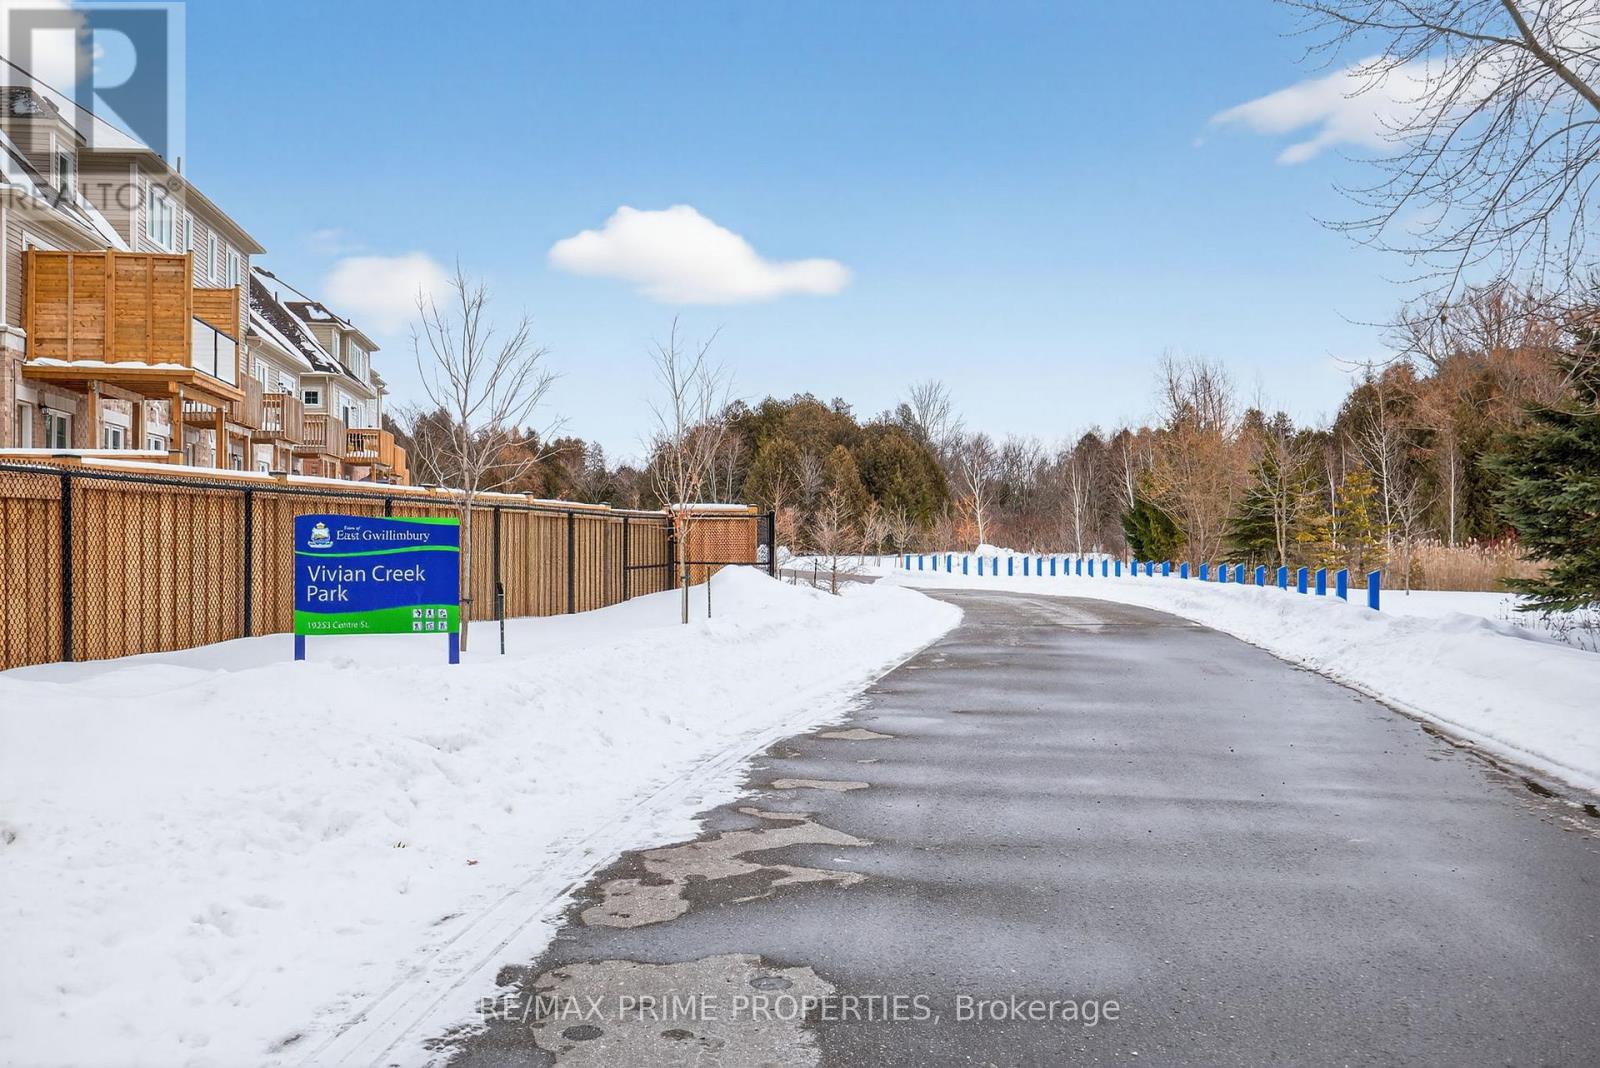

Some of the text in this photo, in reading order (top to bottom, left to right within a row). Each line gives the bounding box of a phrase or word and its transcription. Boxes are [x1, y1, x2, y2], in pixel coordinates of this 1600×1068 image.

[336, 530, 430, 543] East Gwillimbury
[307, 564, 426, 582] Vivian Creek
[307, 584, 349, 602] Park
